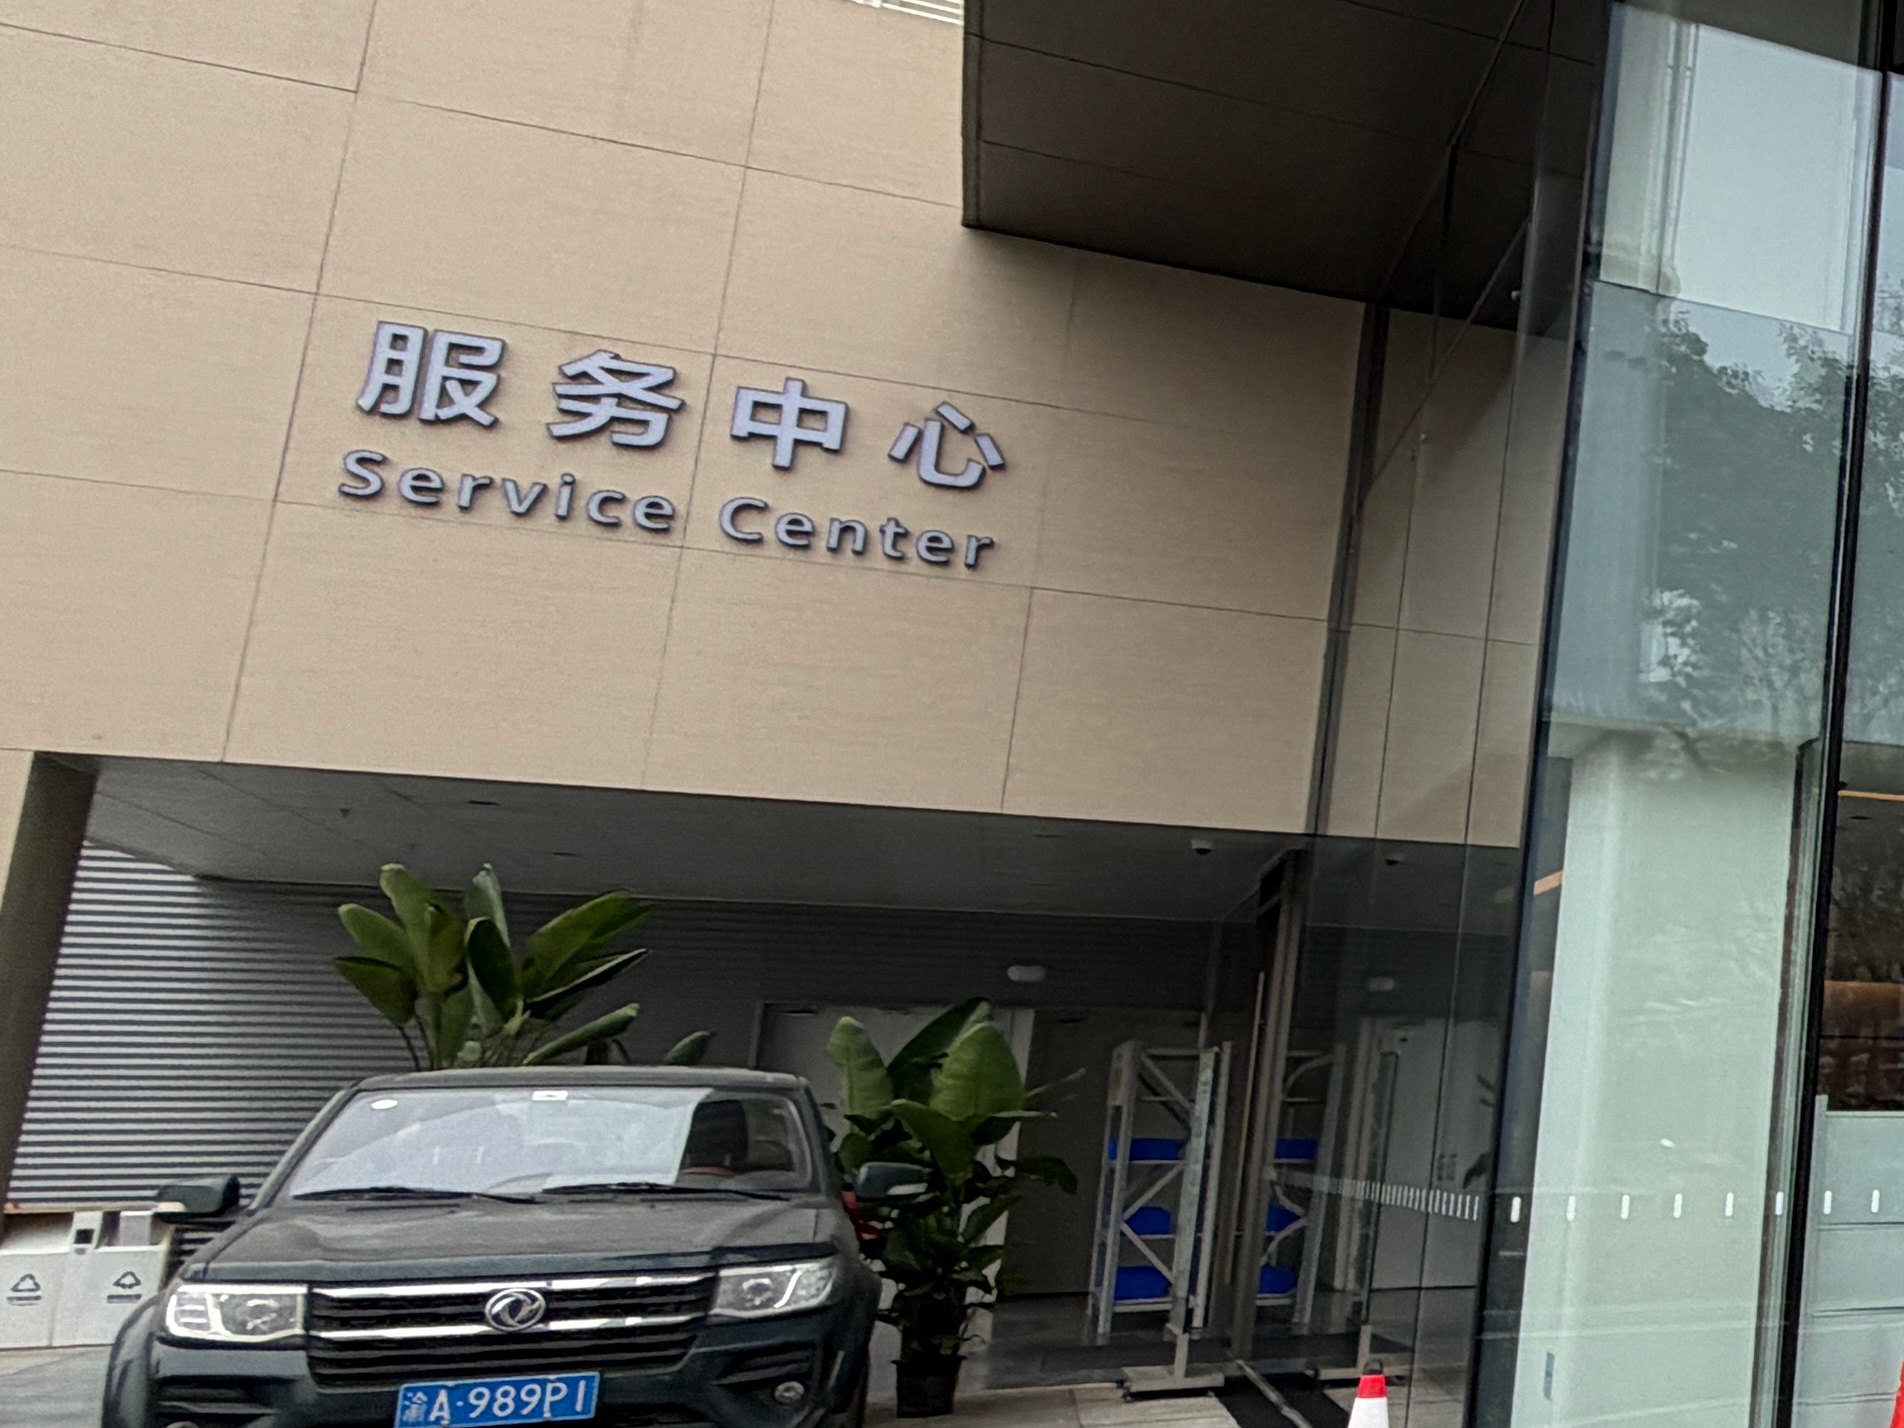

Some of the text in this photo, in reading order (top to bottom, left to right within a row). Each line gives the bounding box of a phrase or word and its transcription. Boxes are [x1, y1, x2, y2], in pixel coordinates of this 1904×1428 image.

[355, 319, 1006, 492] 服务中心
[338, 448, 997, 570] Service Center
